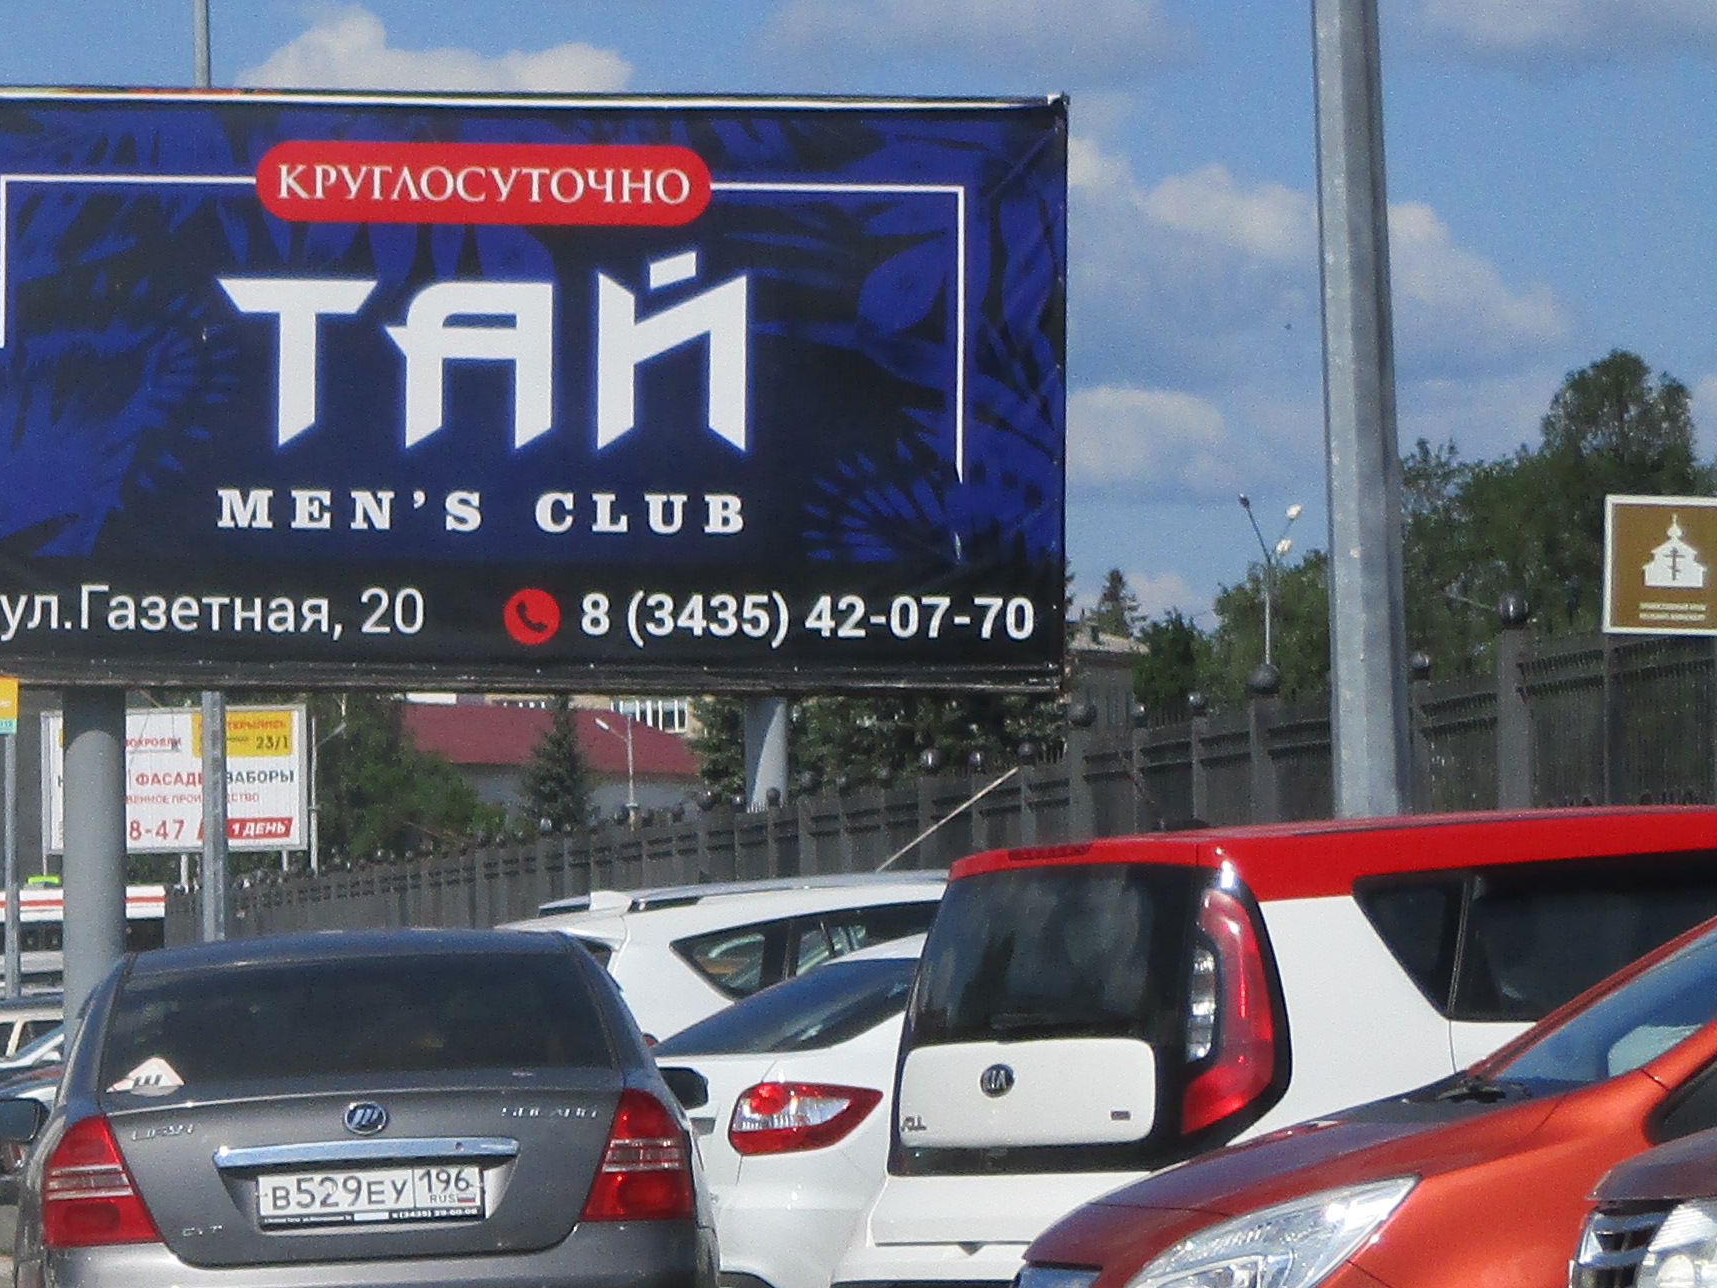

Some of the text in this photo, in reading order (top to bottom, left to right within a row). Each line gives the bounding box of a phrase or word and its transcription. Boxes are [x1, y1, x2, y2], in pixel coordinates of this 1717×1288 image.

[278, 163, 691, 205] КРУГЛОСУТОЧНО
[216, 251, 748, 452] ТАЙ
[534, 492, 745, 535] CLUB
[0, 584, 425, 641] ул.Газетная, 20
[581, 589, 1035, 649] 8 (3435) 42-07-70
[255, 736, 289, 750] 23/1
[242, 821, 287, 837] ДЕНЬ
[272, 1168, 470, 1211] В529ЕУ 196
[429, 1194, 455, 1204] RUS
